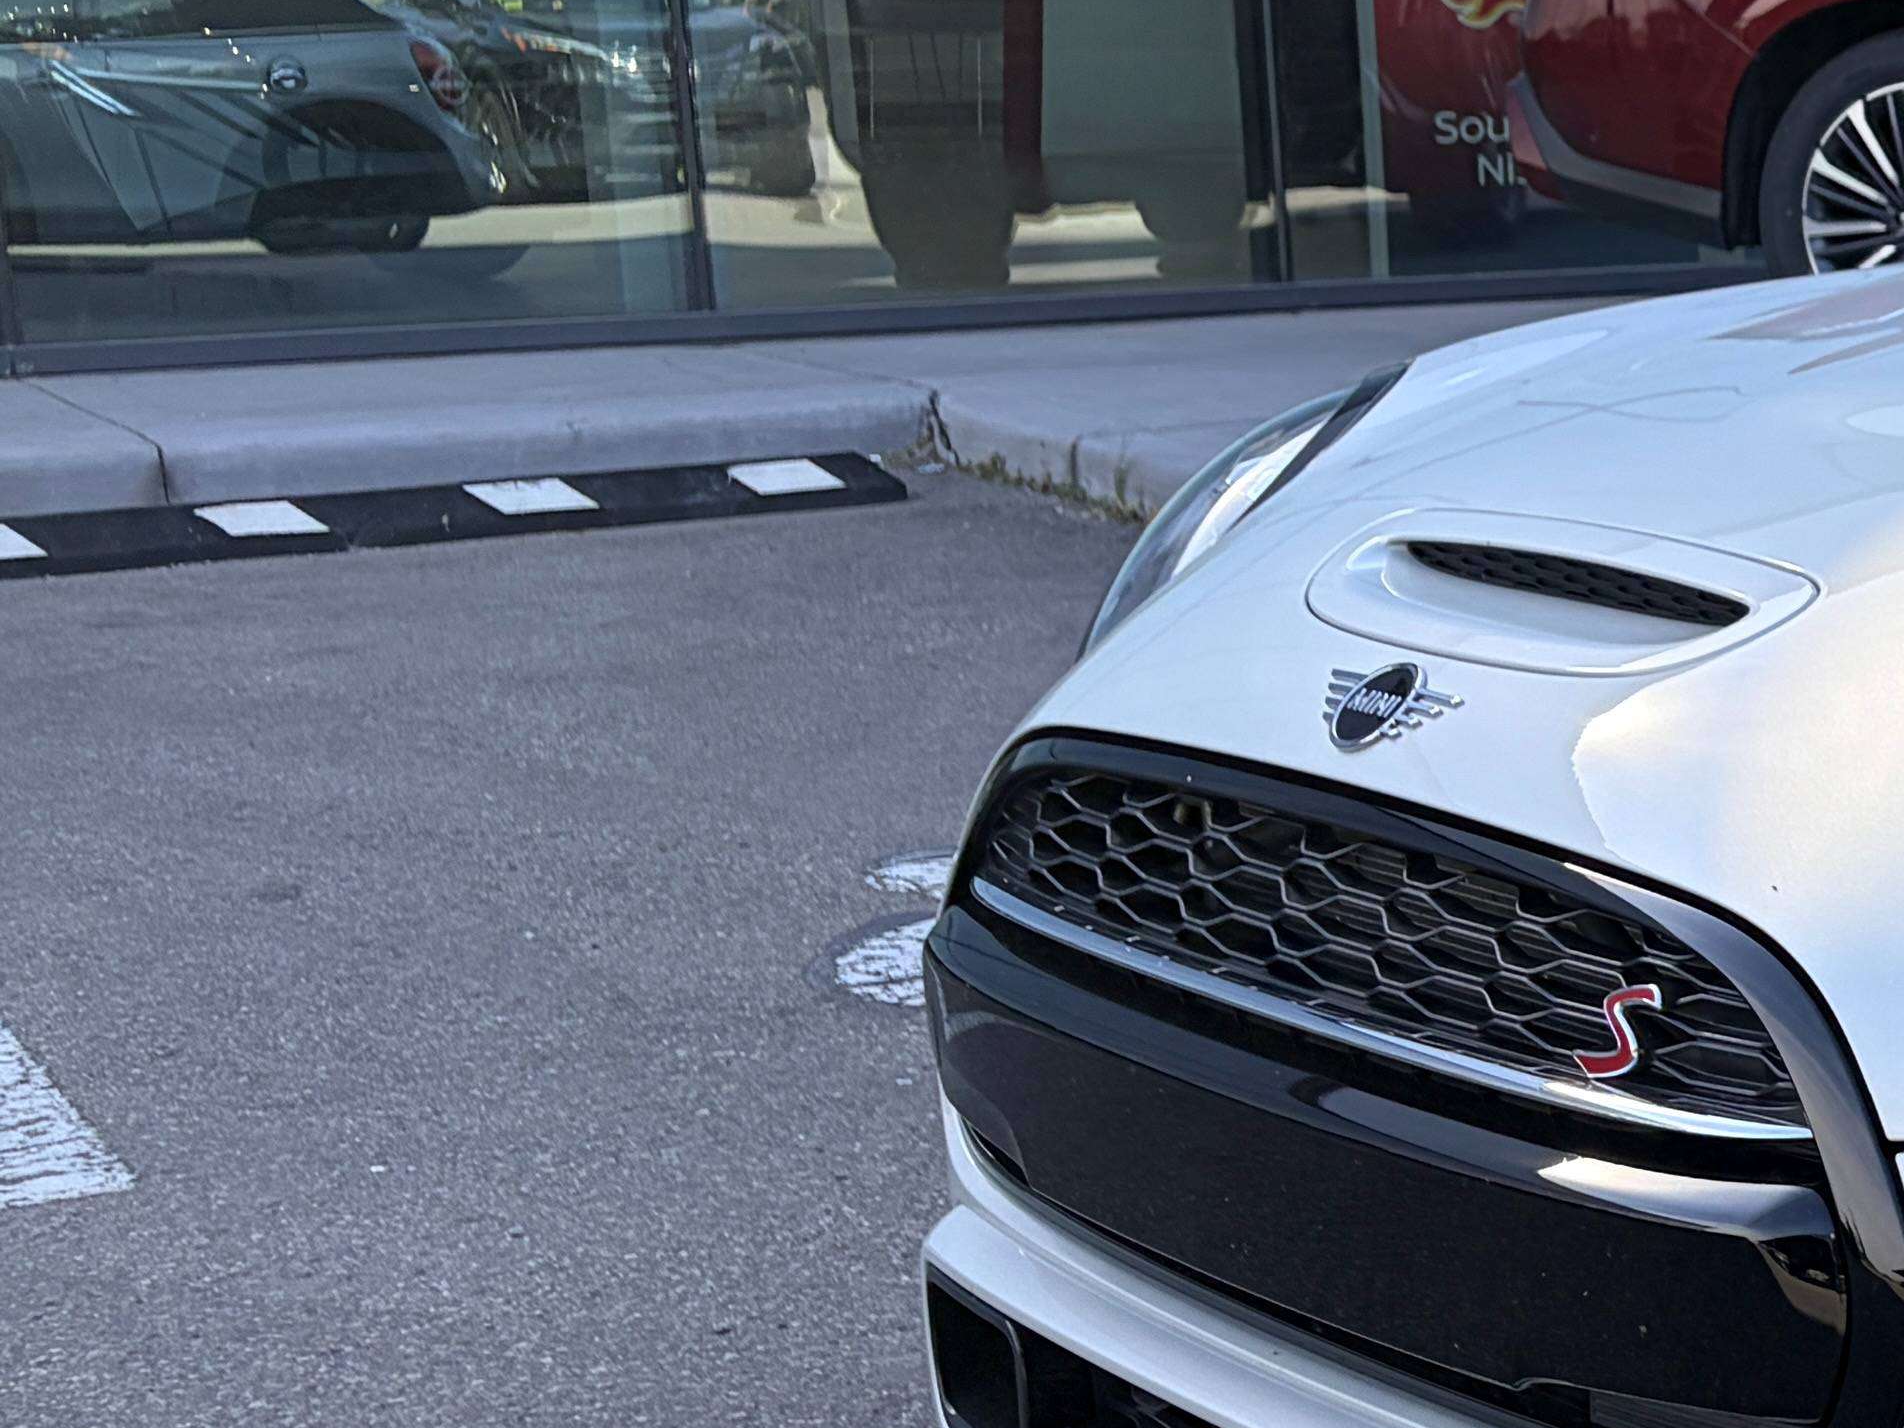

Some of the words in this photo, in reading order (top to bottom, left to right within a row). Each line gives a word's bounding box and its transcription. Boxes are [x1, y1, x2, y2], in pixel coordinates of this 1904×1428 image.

[1433, 109, 1511, 145] Sou
[1346, 686, 1403, 719] MINI
[1571, 983, 1663, 1079] S
